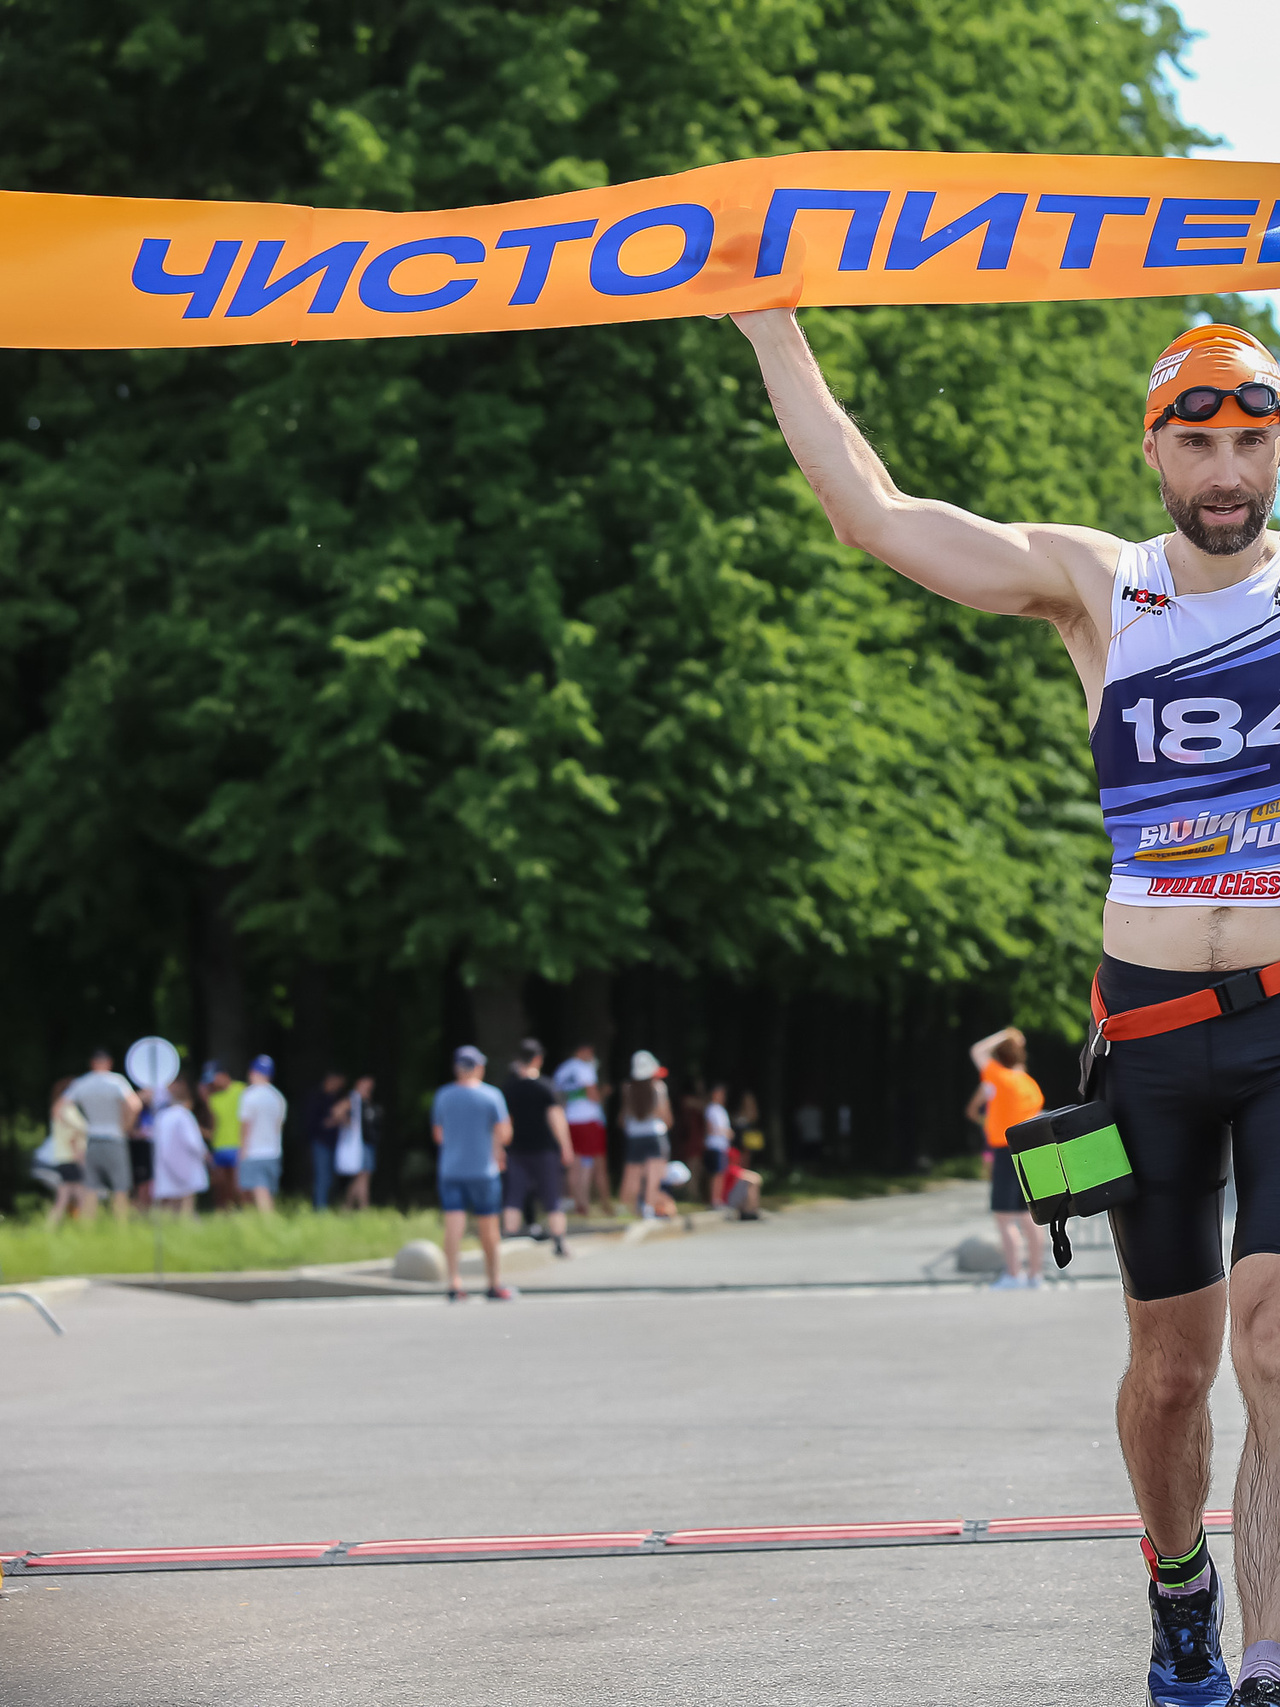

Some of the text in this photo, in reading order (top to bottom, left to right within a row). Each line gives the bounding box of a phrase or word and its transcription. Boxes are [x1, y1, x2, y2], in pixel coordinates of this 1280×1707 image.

[132, 203, 715, 319] ЧИСТО
[1256, 805, 1265, 817] 4
[1154, 873, 1217, 895] World
